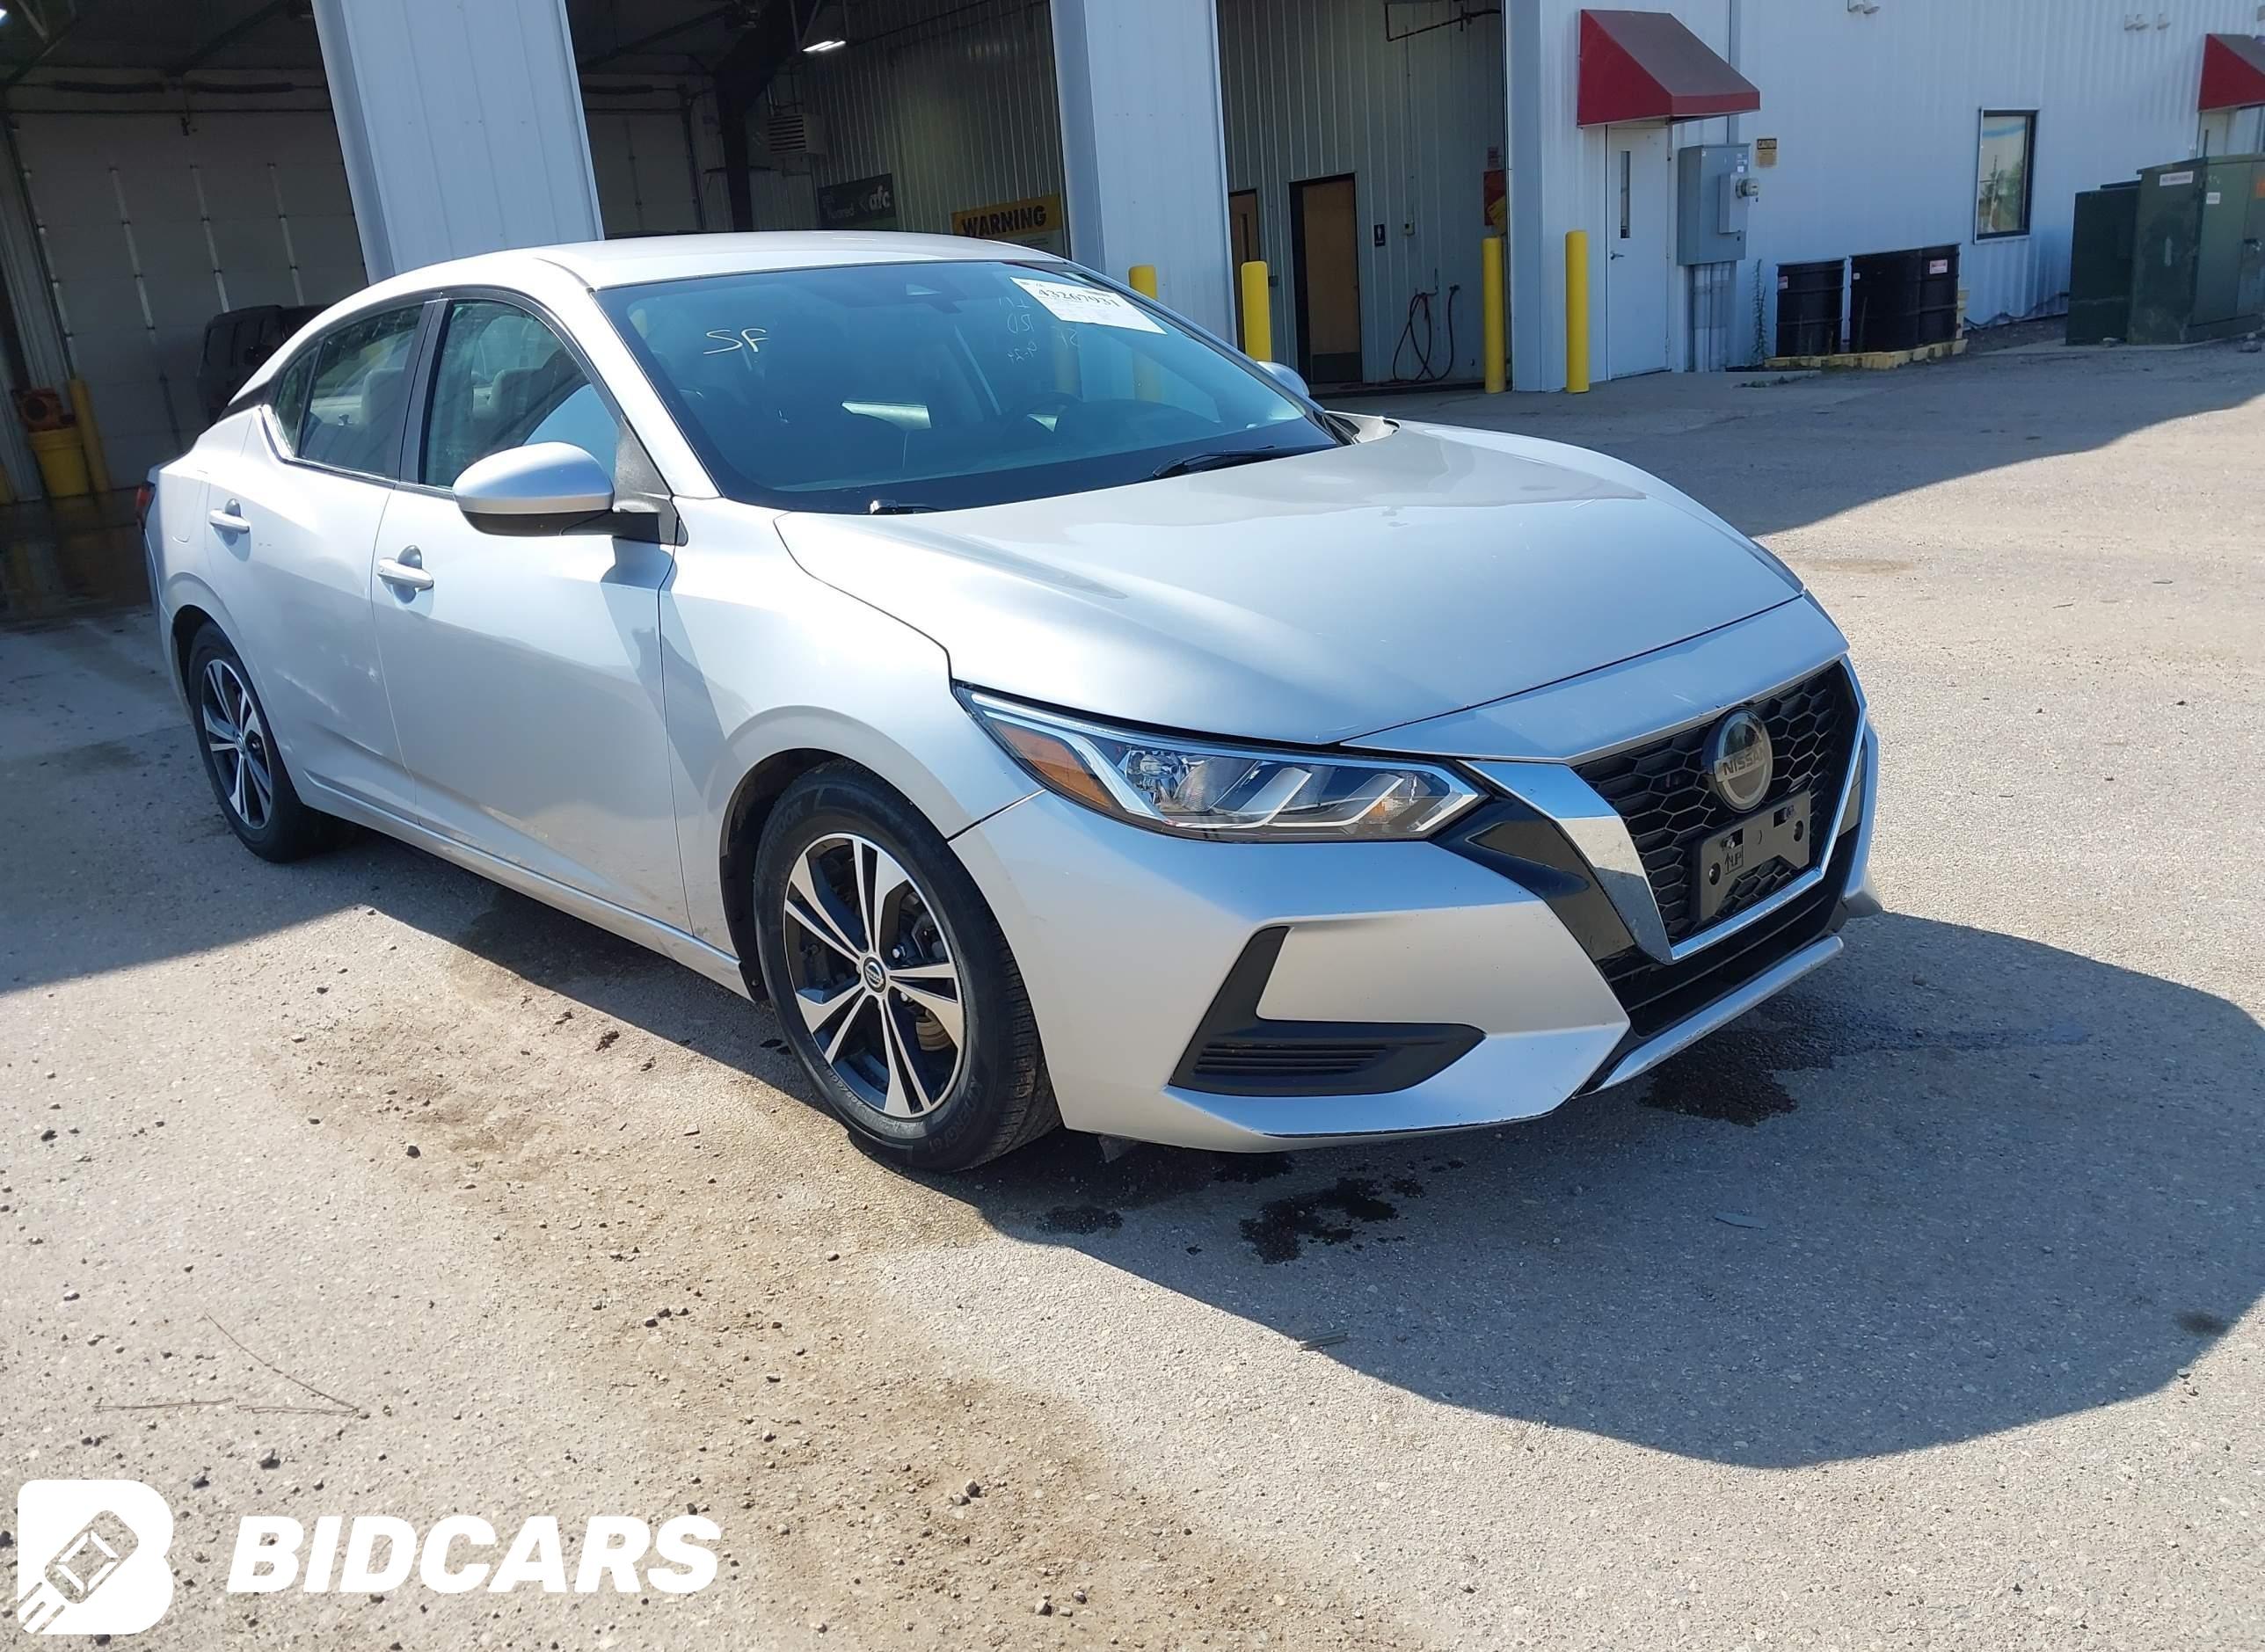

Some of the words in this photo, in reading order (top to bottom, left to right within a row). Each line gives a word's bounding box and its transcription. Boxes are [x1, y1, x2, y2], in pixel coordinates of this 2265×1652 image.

[868, 185, 891, 211] afc
[961, 204, 1046, 237] WARNING
[1038, 288, 1121, 308] 43267931
[703, 327, 770, 354] SF
